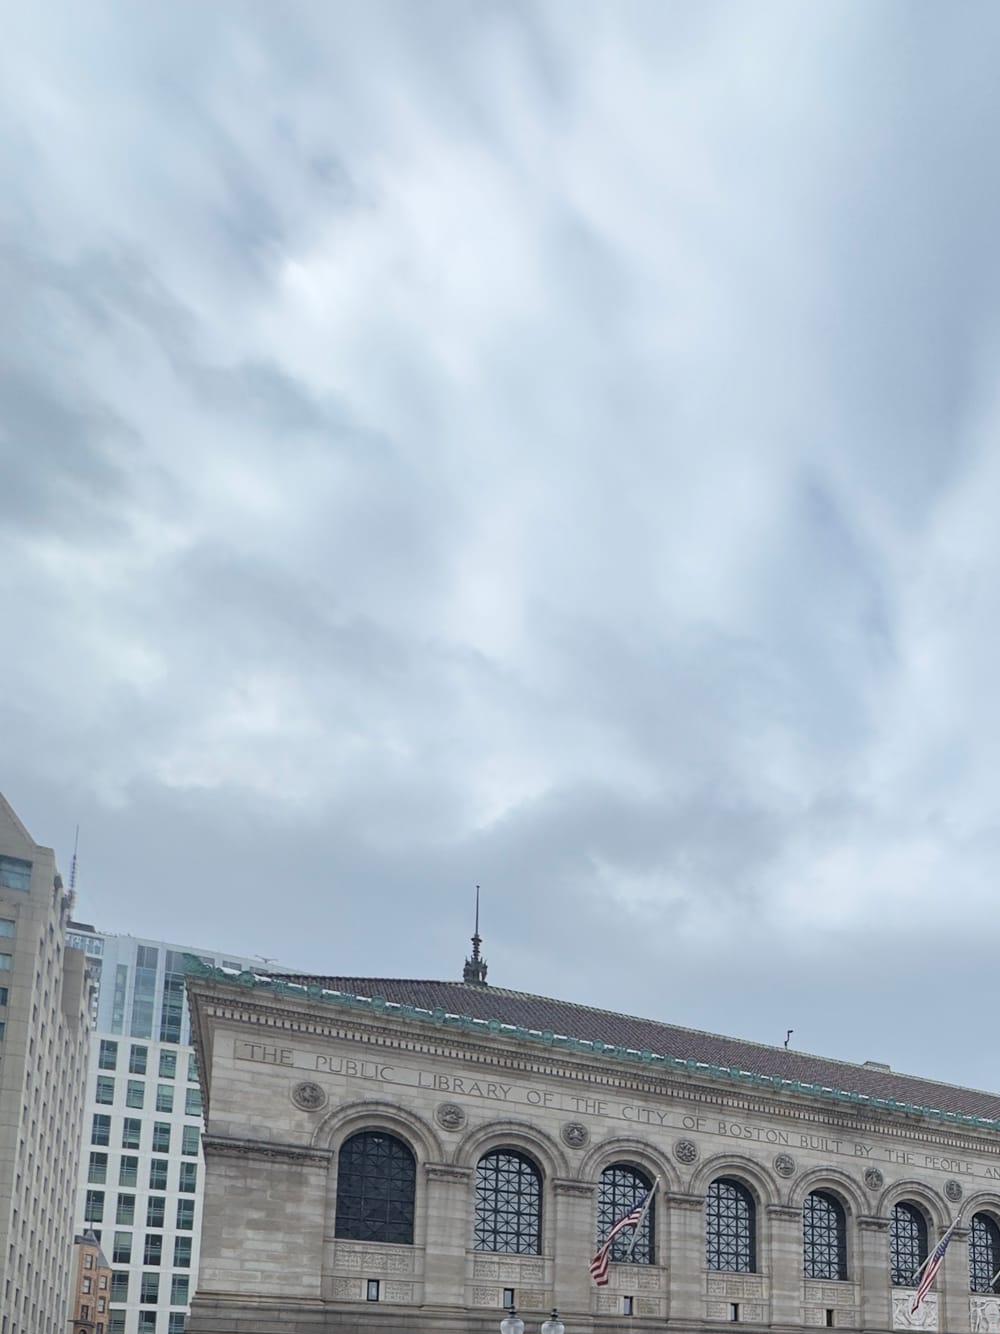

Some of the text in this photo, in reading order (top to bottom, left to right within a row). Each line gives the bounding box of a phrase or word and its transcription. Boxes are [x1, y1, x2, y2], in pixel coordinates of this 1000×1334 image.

[244, 1043, 294, 1066] THE
[315, 1055, 394, 1081] PUBLIC
[418, 1072, 512, 1100] LIBRARY
[526, 1090, 553, 1106] OF
[571, 1096, 608, 1116] THE
[622, 1106, 668, 1124] CITY
[682, 1116, 707, 1129] OF
[718, 1122, 789, 1144] BOSTON
[800, 1135, 843, 1152] BUILT
[854, 1143, 874, 1156] BY
[886, 1149, 914, 1166] THE
[924, 1155, 973, 1173] PEOPLE
